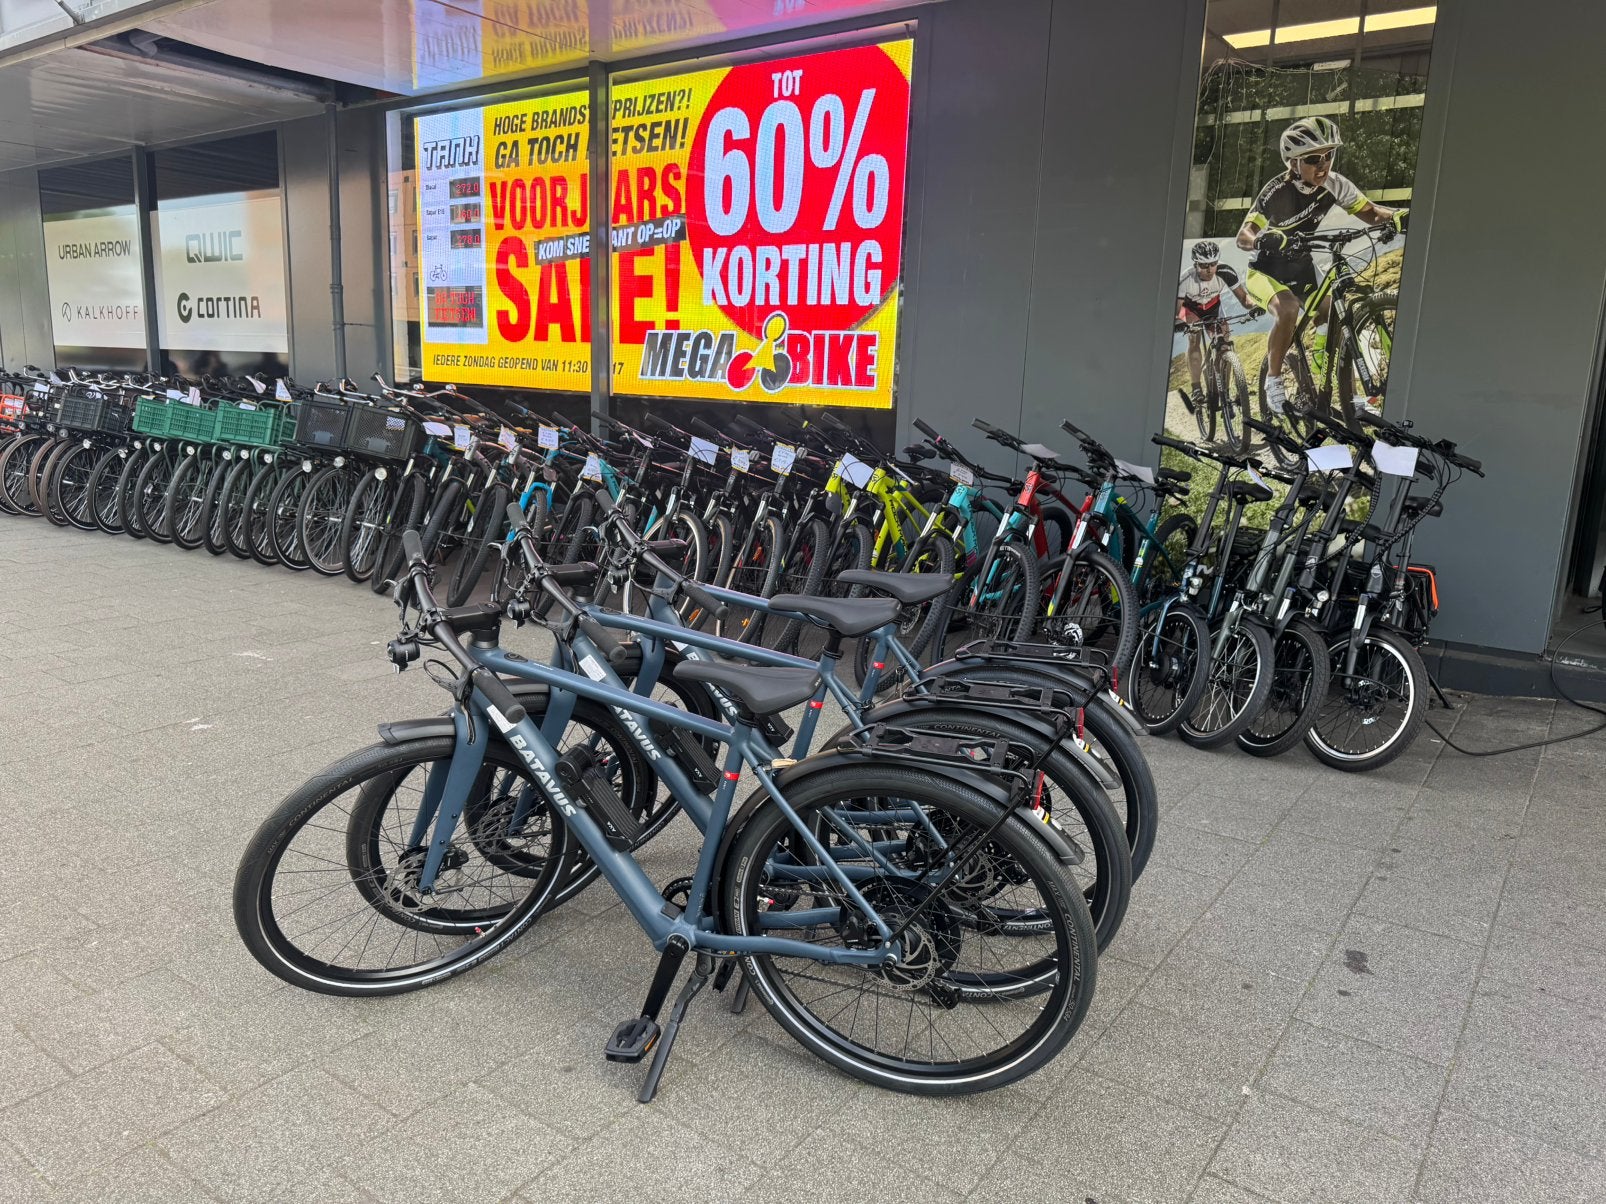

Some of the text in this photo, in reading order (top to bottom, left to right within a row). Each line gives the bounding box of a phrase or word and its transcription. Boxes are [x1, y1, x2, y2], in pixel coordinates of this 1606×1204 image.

[771, 69, 803, 98] TOT
[493, 113, 528, 136] HOGE
[494, 140, 520, 169] GA
[527, 132, 580, 166] TOCH
[704, 88, 890, 236] 60%
[58, 240, 132, 260] URBAN ARROW
[185, 230, 244, 263] QWIC
[538, 240, 564, 260] KOM
[637, 218, 682, 243] OP=OP
[702, 239, 883, 307] KORTING
[77, 305, 139, 320] KALKHOFF
[432, 354, 461, 367] IEDERE
[463, 355, 495, 369] ZONDAG
[497, 356, 539, 371] GEOPEND
[541, 359, 558, 372] VAN
[561, 360, 589, 374] 11:30
[639, 329, 879, 388] MEGA BIKE
[509, 734, 577, 817] BATAVUS
[1064, 912, 1081, 981] CONTINENTAL
